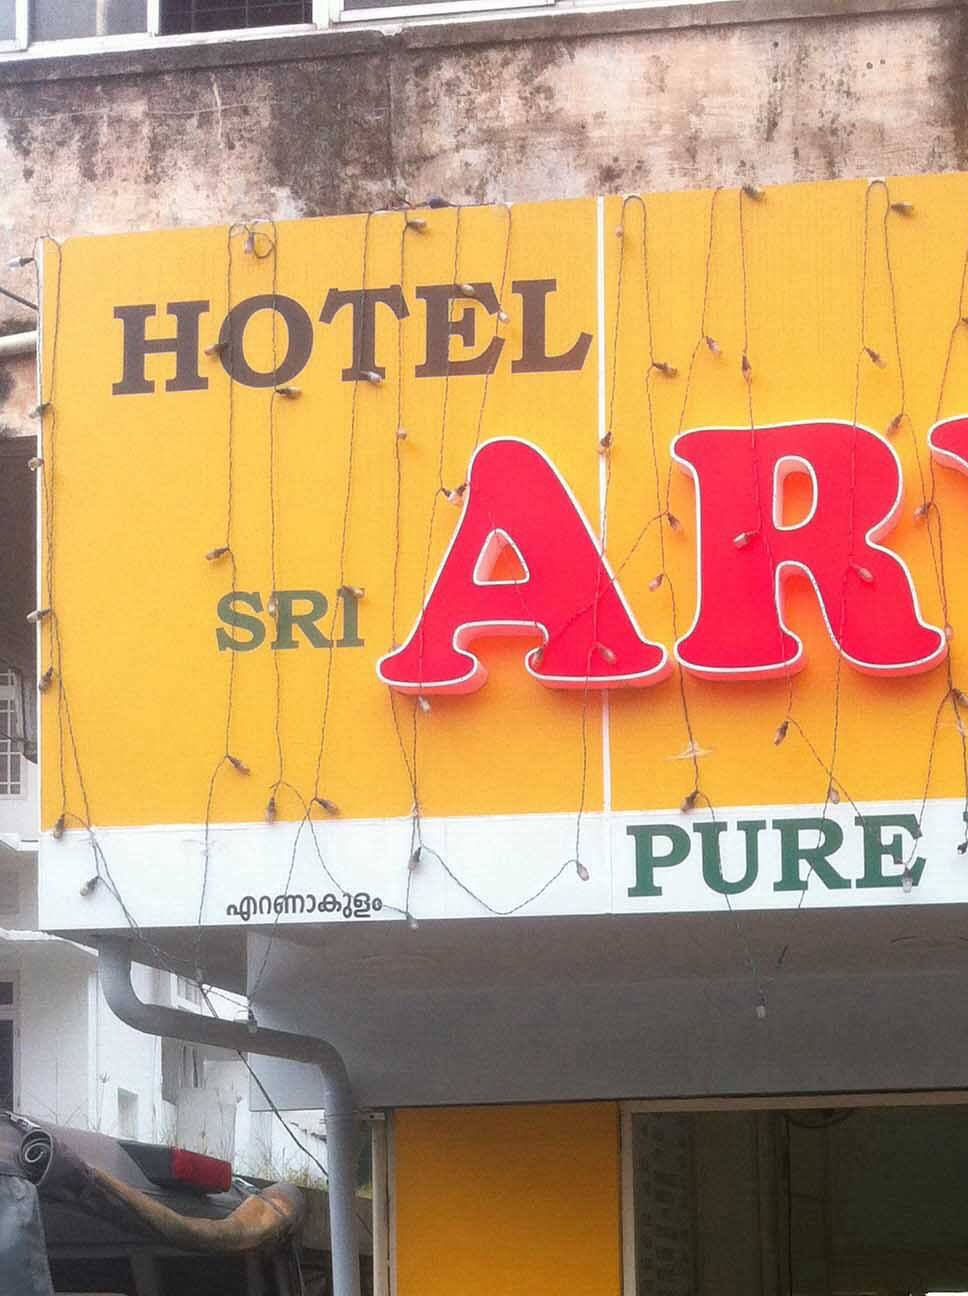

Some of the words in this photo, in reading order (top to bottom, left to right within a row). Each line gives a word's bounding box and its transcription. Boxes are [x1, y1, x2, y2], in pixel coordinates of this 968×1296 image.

[112, 278, 593, 396] HOTEL
[215, 588, 365, 653] SRI
[626, 813, 926, 897] PURE
[226, 892, 383, 921] എറണാകുളം
